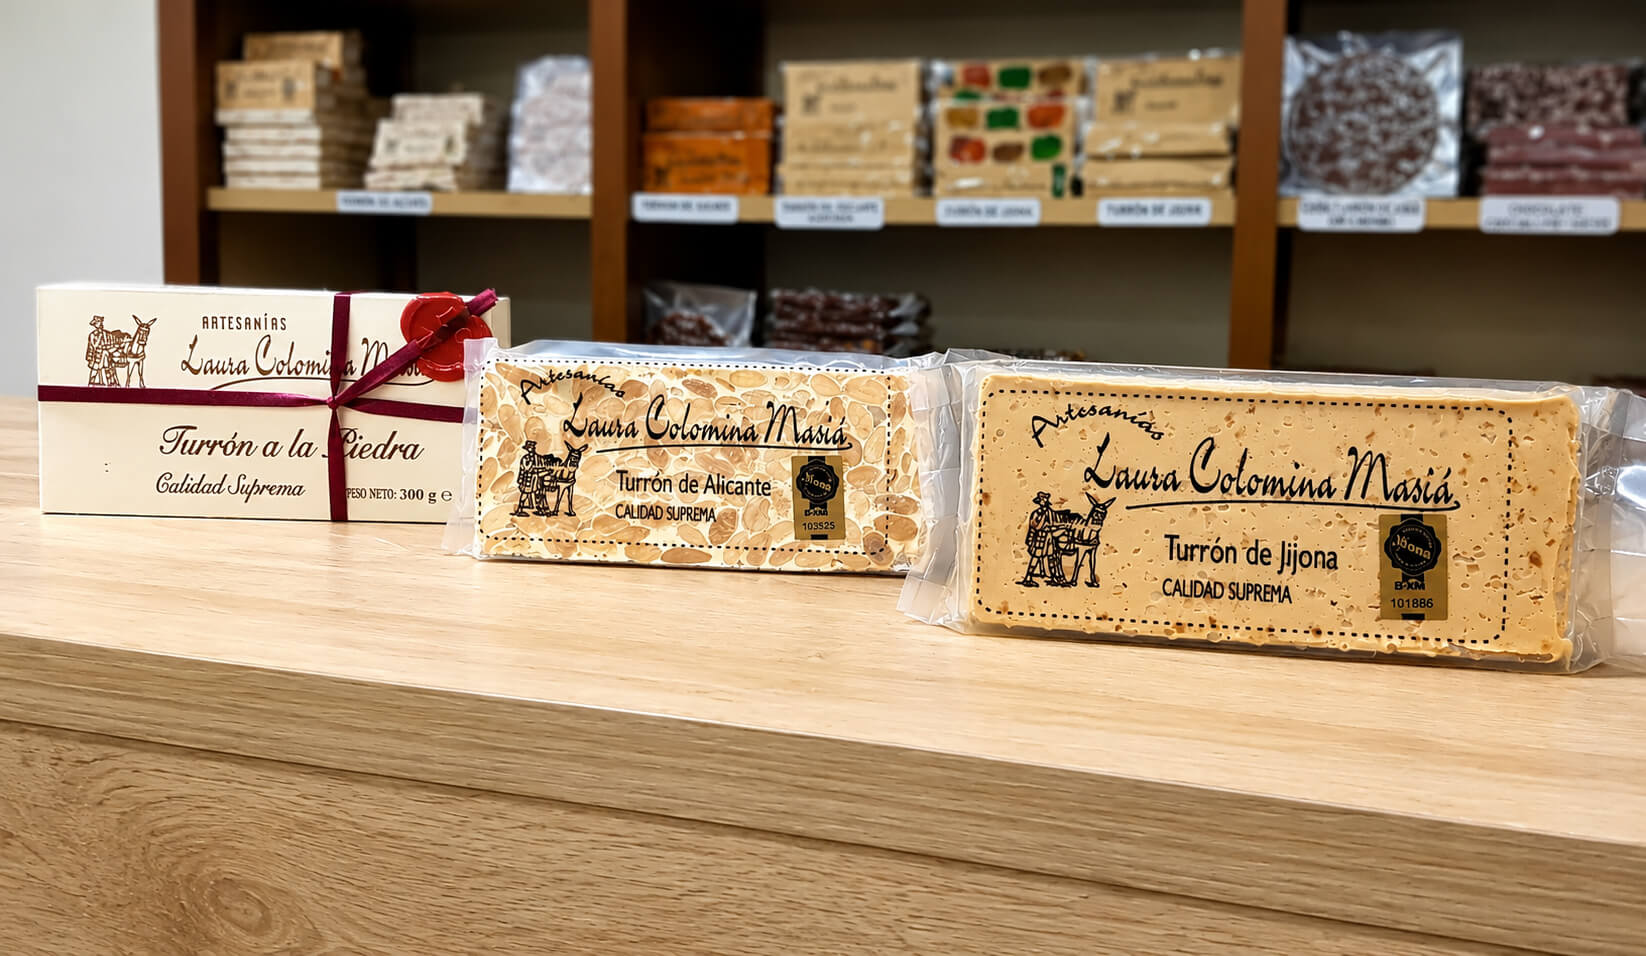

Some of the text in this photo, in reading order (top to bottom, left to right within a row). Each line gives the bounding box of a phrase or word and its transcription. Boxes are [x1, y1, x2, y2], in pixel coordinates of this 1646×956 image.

[202, 313, 287, 331] ARTESANÍAS
[181, 334, 250, 376] Laura
[255, 334, 357, 377] Colomia
[563, 391, 847, 446] Laura Colomina Masiá
[1031, 404, 1165, 448] Artesanías
[159, 425, 425, 460] Turrón a la Piedra
[615, 469, 772, 497] Turrón de Alicante
[1083, 432, 1453, 503] Laura Colomina Masiá
[155, 471, 306, 503] Calidad Suprema
[346, 487, 367, 499] PESO
[369, 487, 397, 500] NETO:
[399, 488, 424, 500] 300
[428, 491, 437, 504] g
[615, 503, 717, 523] CALIDAD SUPREMA
[1164, 534, 1339, 576] Turrón de Jijona
[1162, 577, 1293, 604] CALIDAD SUPREMA
